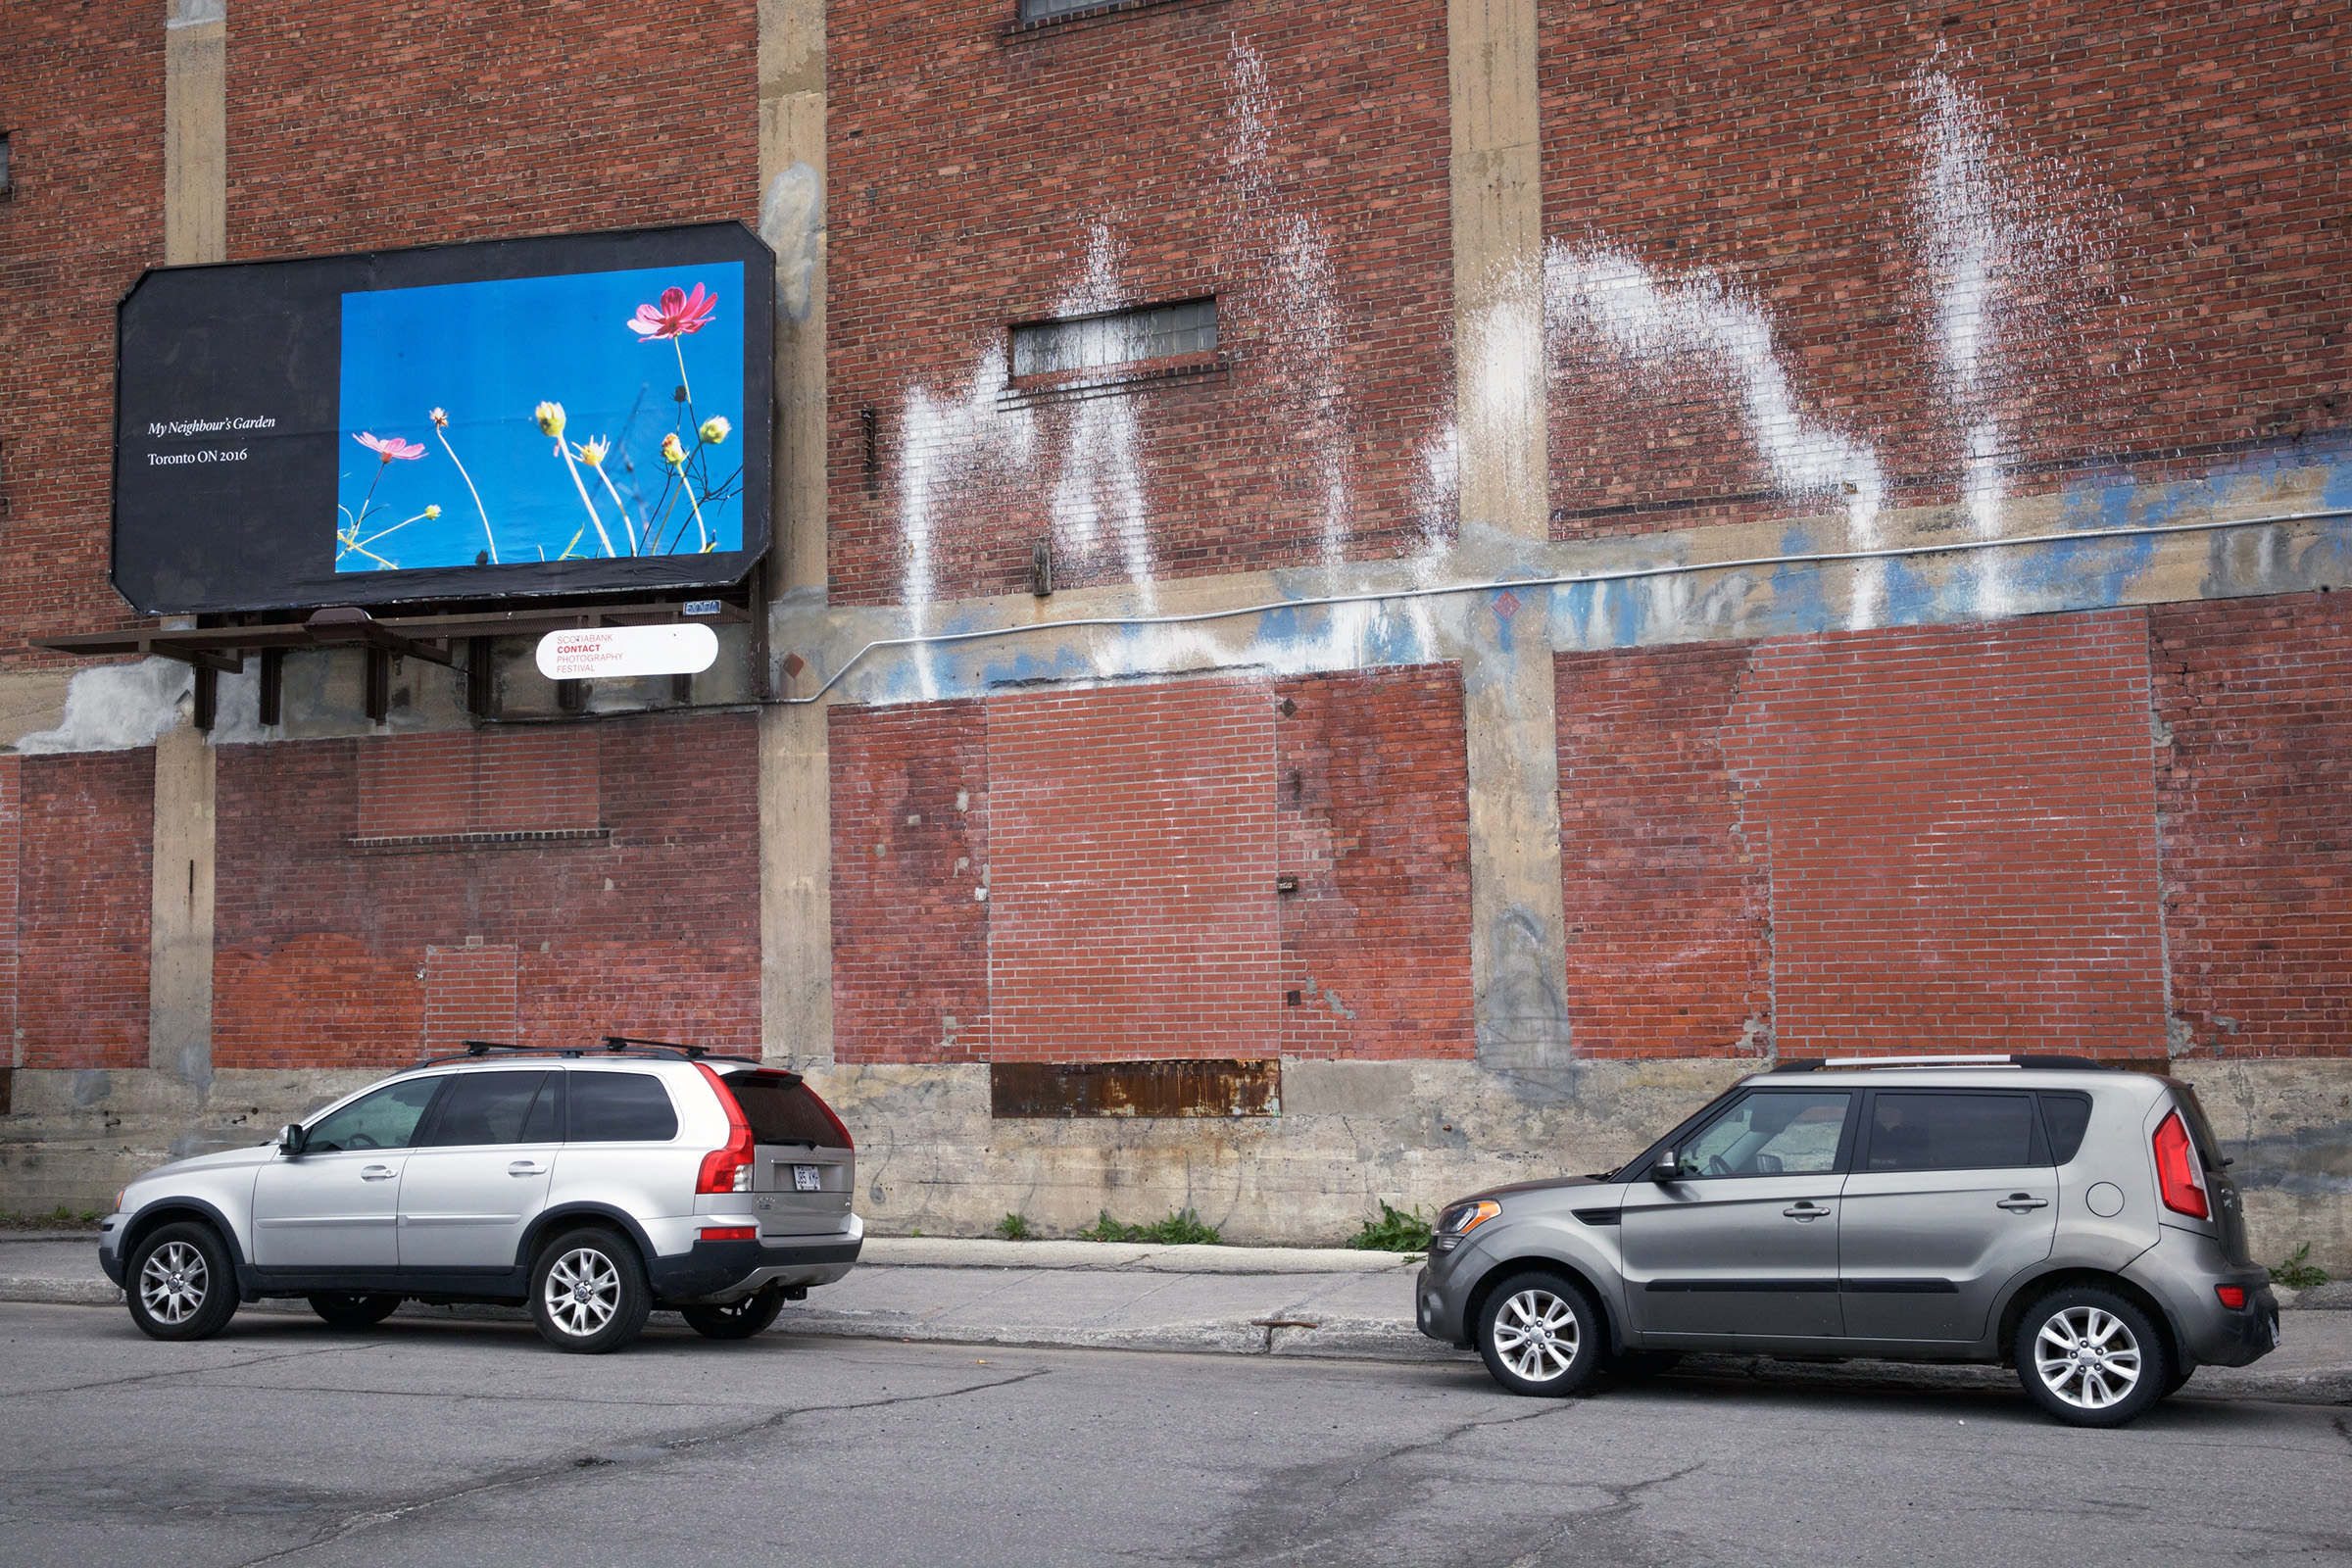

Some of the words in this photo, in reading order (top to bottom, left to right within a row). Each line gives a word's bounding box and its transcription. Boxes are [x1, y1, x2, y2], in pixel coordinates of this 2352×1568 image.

[147, 422, 167, 438] My
[168, 417, 231, 436] Neighbour’s
[233, 416, 276, 430] Garden
[147, 451, 195, 466] Toronto
[197, 450, 218, 463] ON
[220, 448, 248, 462] 2016
[557, 634, 613, 645] SCOTIABANK
[557, 644, 601, 654] CONTACT
[557, 653, 623, 663] PHOTOGRAPHY
[557, 664, 596, 673] FESTIVAL
